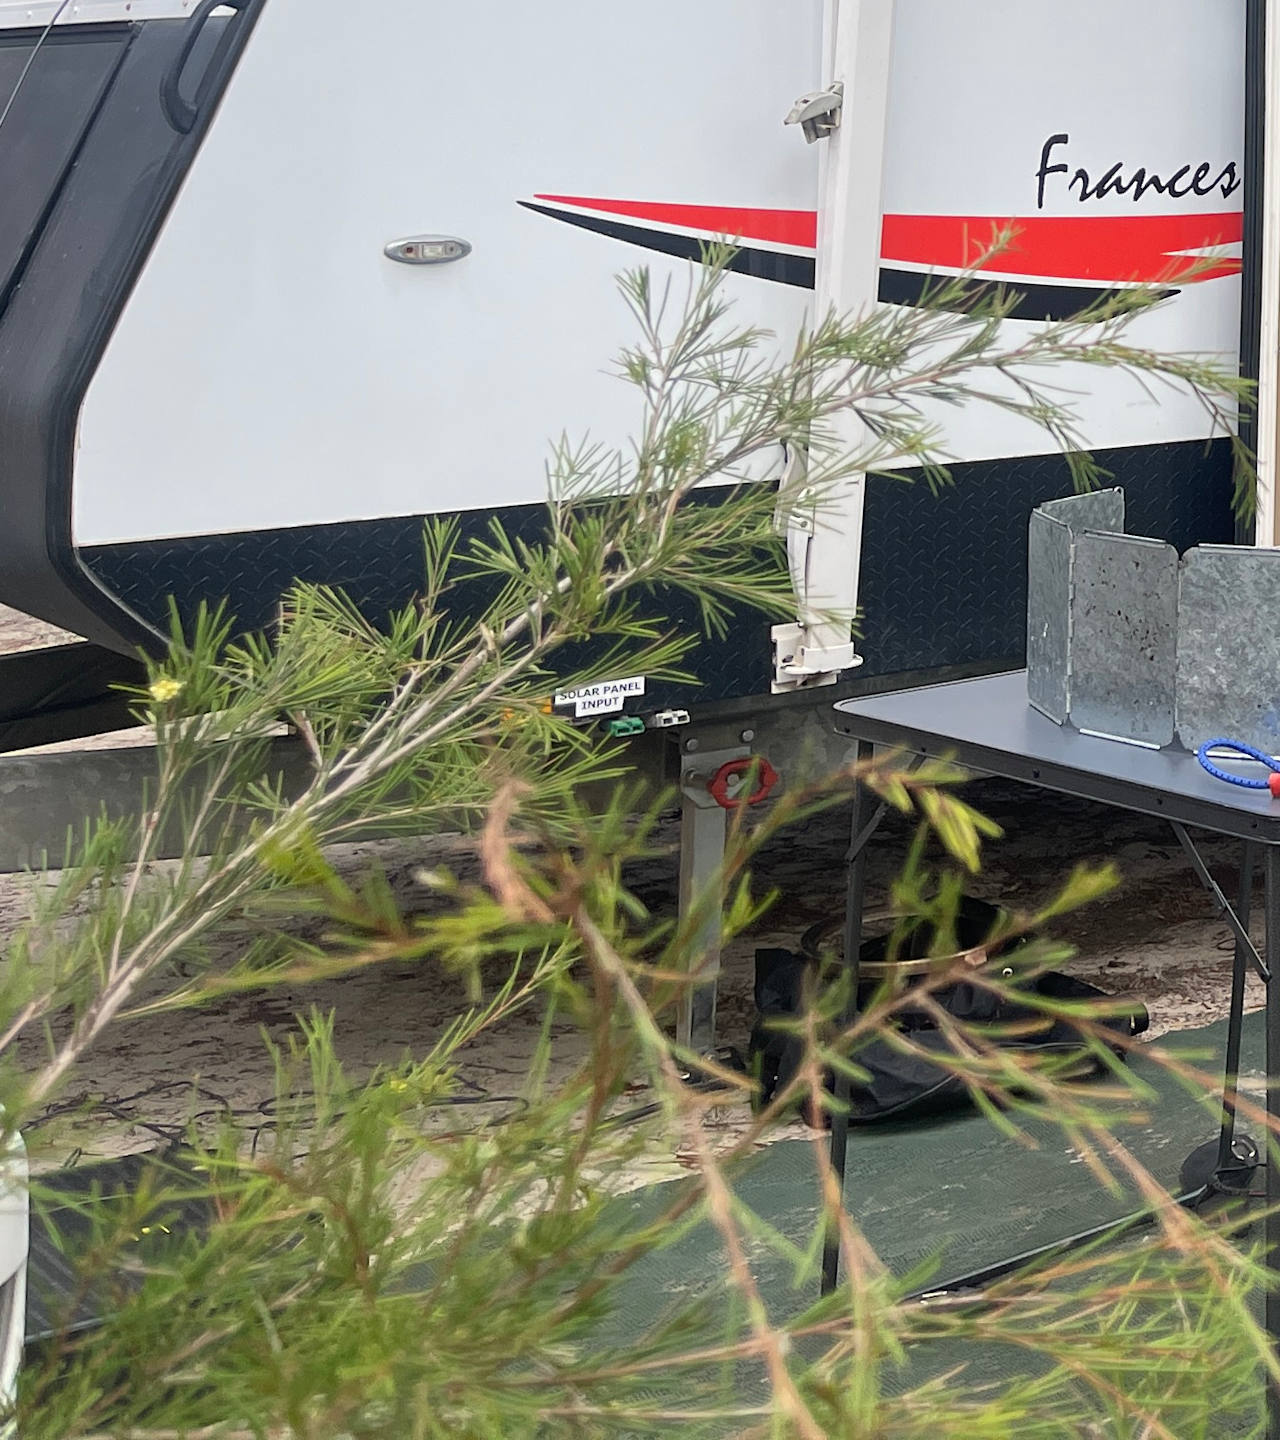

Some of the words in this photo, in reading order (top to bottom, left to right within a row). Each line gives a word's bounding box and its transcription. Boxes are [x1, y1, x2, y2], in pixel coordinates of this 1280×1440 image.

[1035, 133, 1241, 209] Frances
[560, 688, 600, 701] SOLAR
[603, 681, 641, 695] PANEL
[581, 696, 619, 710] INPUT
